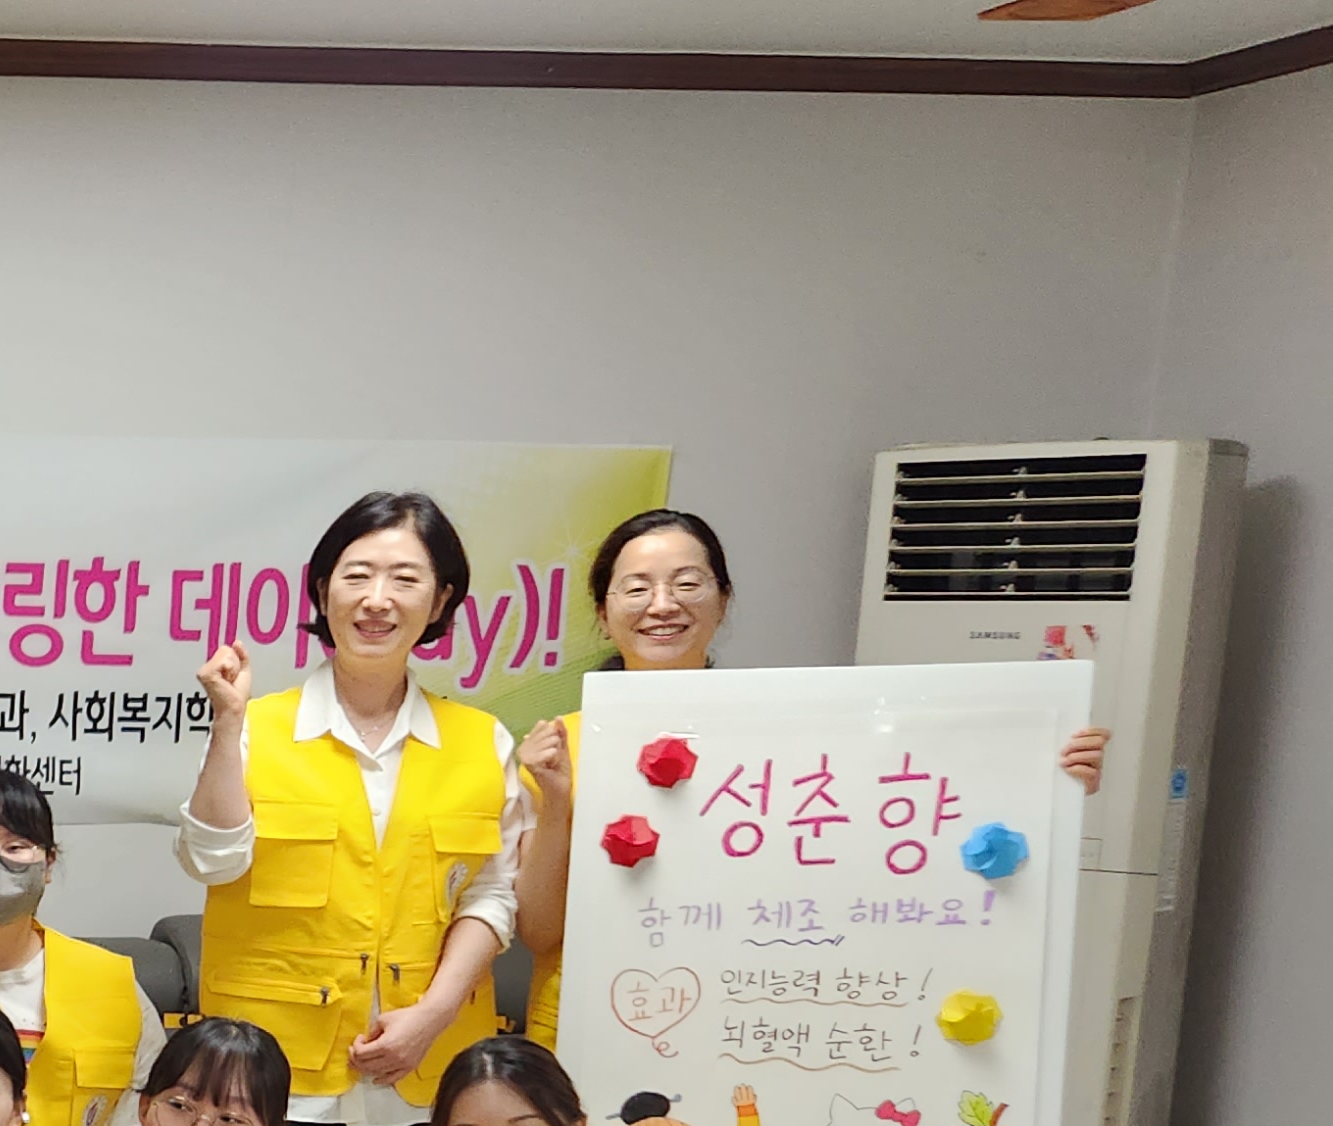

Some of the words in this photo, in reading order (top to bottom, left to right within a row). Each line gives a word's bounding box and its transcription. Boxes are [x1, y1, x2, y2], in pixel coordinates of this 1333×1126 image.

[638, 897, 722, 948] 함께
[746, 898, 825, 933] 체조
[848, 889, 996, 928] 해봐요!
[627, 981, 692, 1022] 효과
[720, 967, 822, 999] 인지능력
[721, 1014, 811, 1059] 뇌혈액
